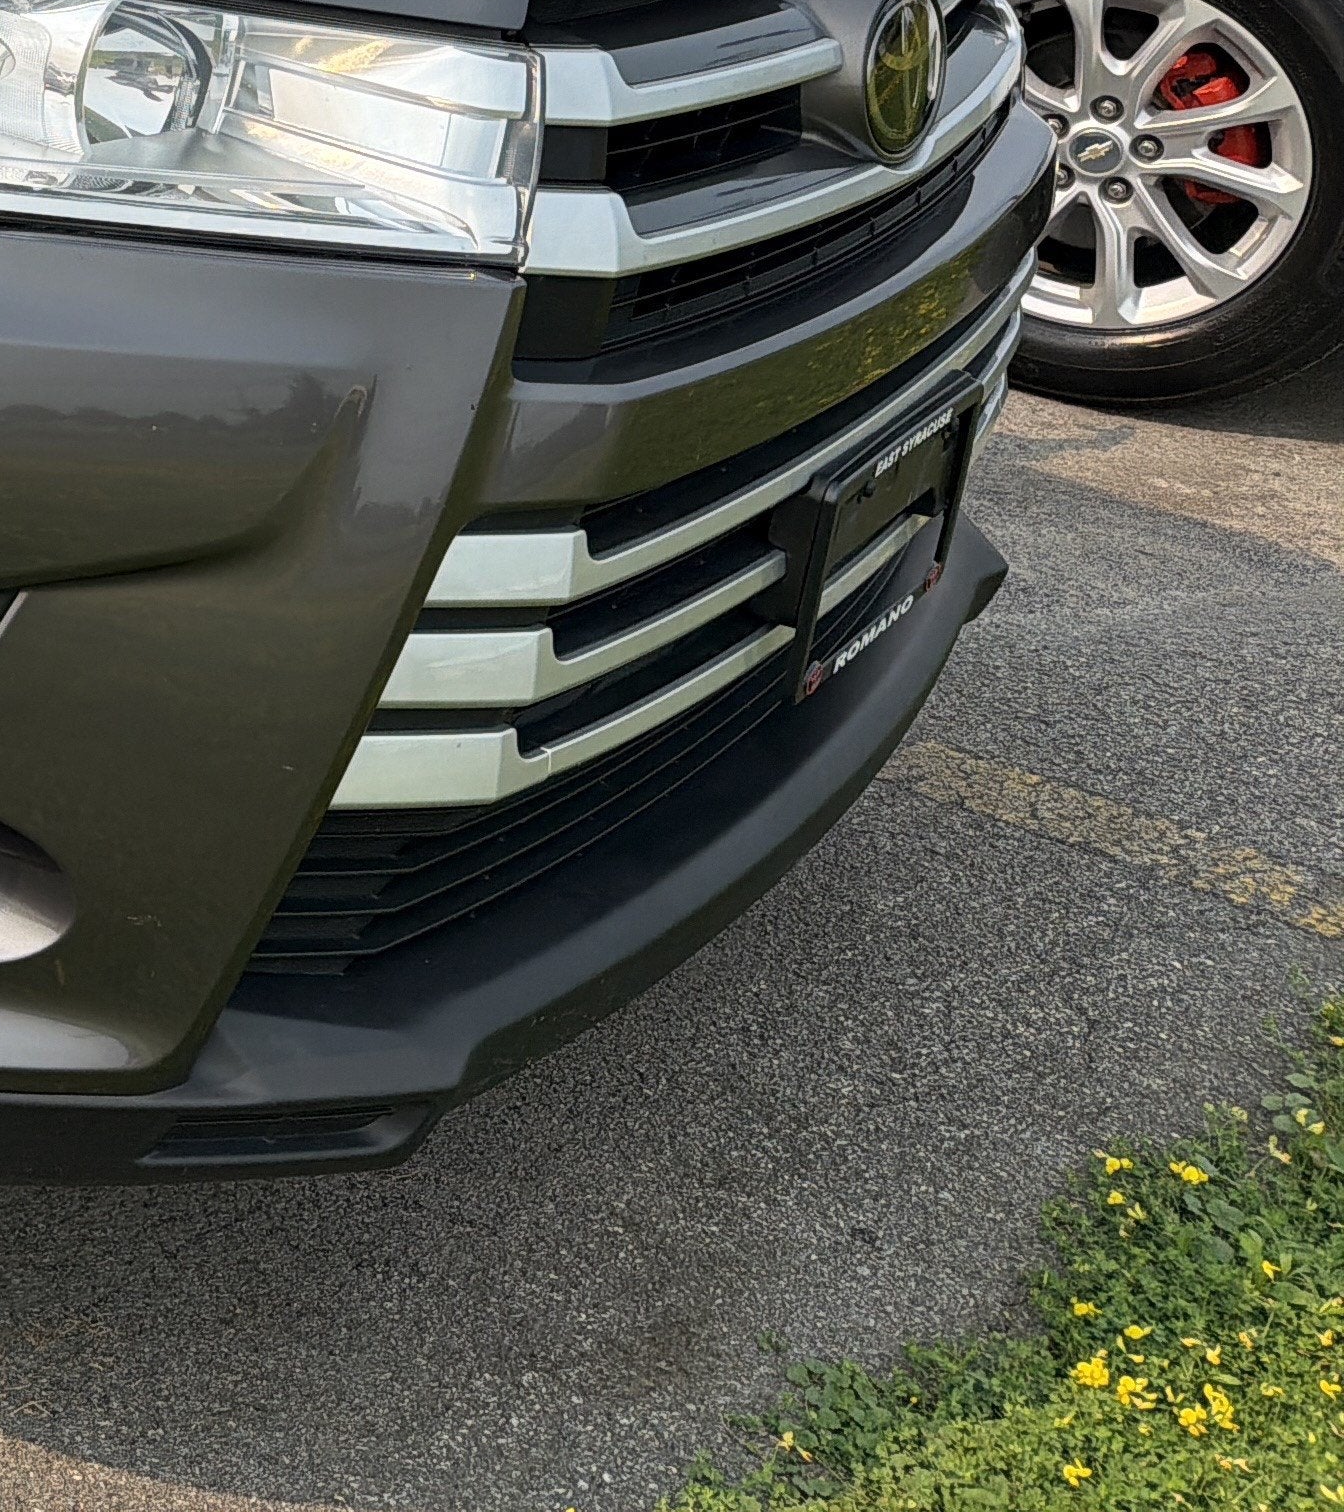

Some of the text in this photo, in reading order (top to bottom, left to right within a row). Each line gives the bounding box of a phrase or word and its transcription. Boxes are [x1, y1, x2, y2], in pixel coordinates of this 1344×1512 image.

[874, 407, 954, 479] EAST SYRACUSE
[833, 594, 914, 675] ROMANO
